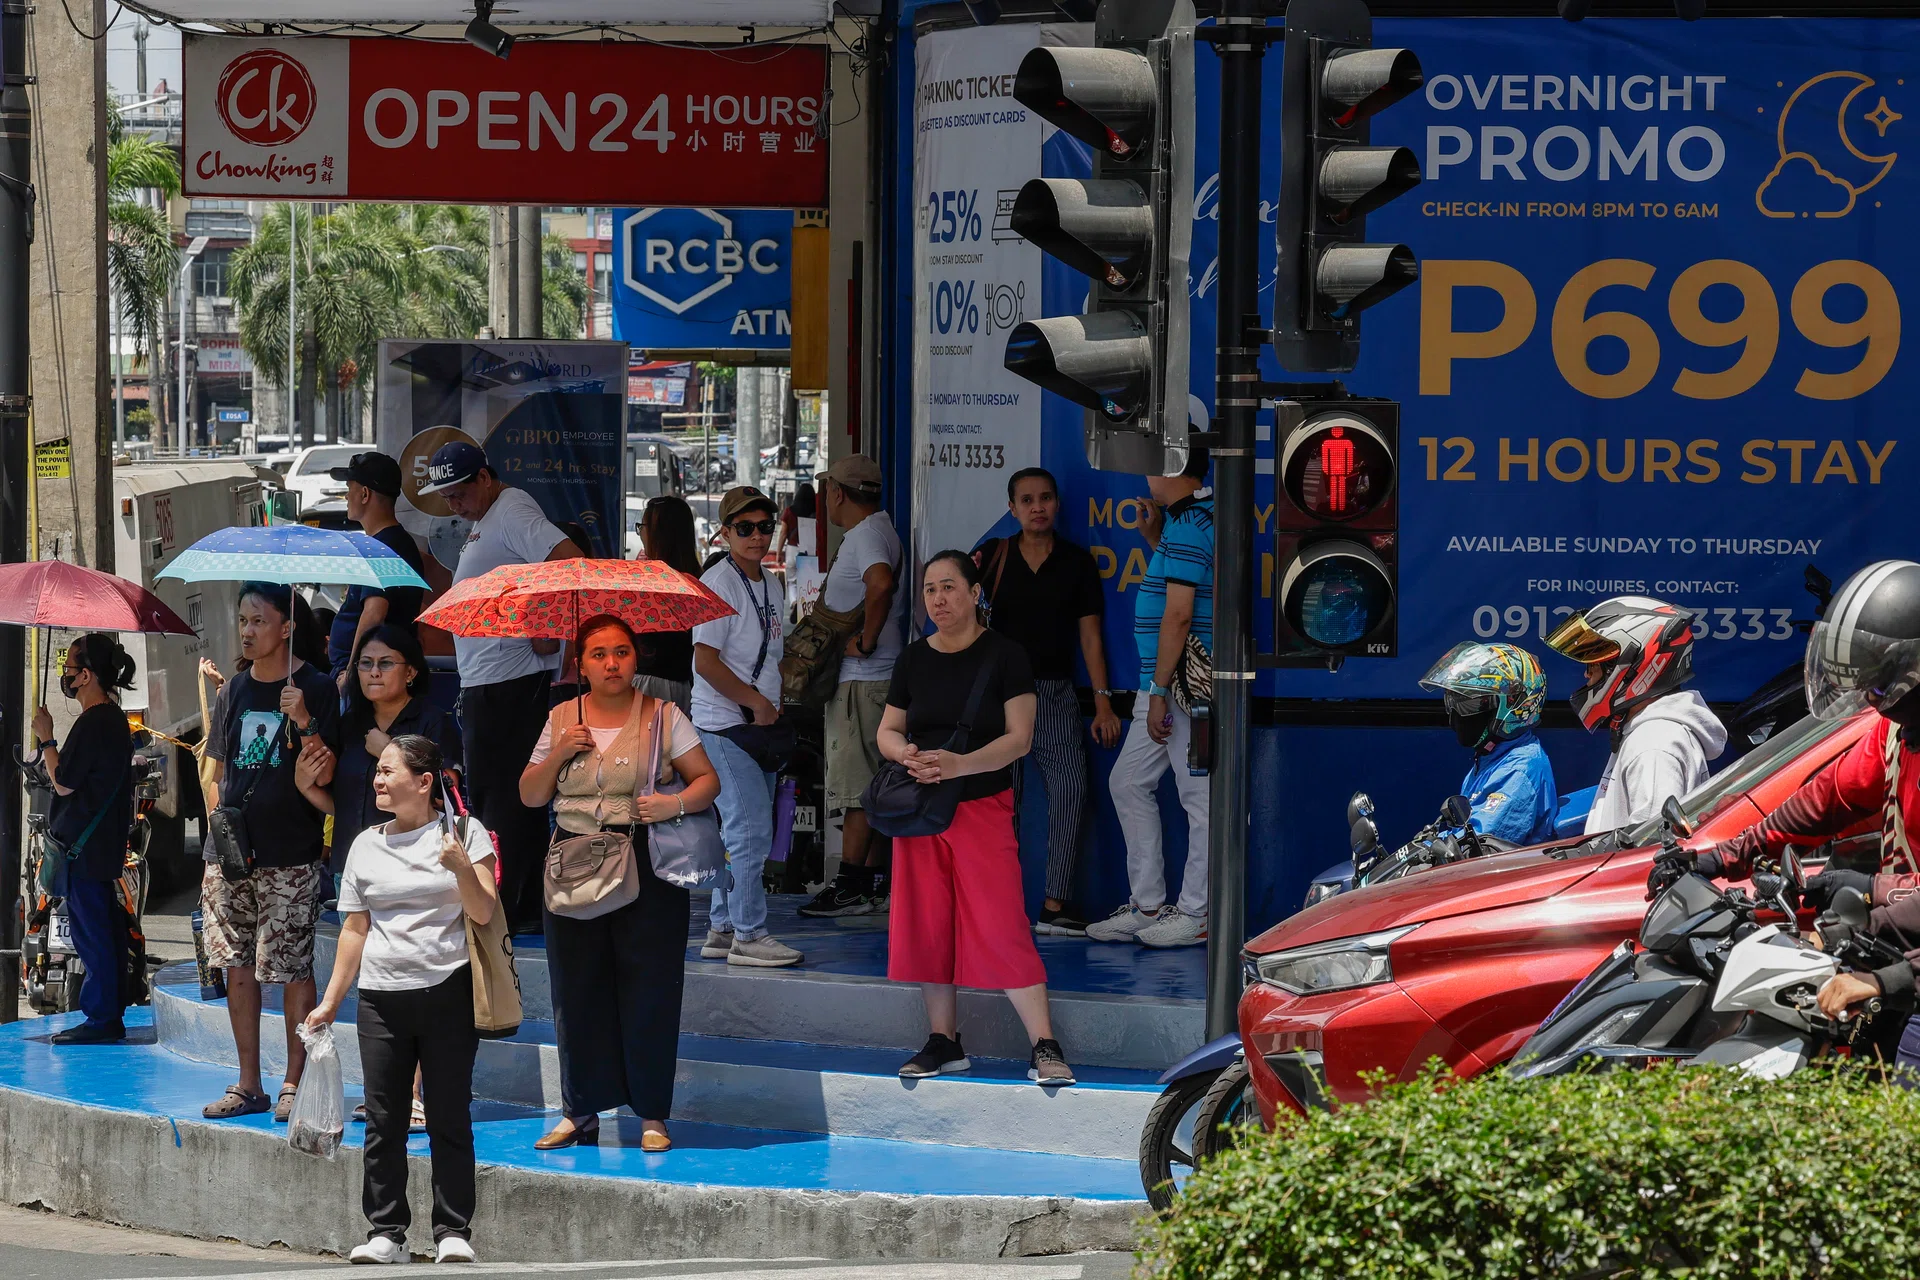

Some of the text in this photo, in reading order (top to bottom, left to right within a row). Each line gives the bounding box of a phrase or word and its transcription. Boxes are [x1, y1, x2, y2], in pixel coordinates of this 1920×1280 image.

[228, 63, 304, 132] Ck
[966, 74, 1017, 101] TICKE
[1426, 75, 1726, 111] OVERNIGHT
[363, 88, 676, 154] OPEN 24
[686, 94, 818, 126] HOURS
[944, 116, 953, 128] AS
[954, 112, 991, 128] DISCOUNT
[993, 110, 1026, 124] CARDS
[686, 130, 815, 153] 小时营业
[1427, 126, 1725, 182] PROMO
[196, 151, 317, 185] Chowking
[929, 189, 982, 243] 25%
[1422, 201, 1719, 218] CHECK-IN FROM 8PM TO 6AM
[645, 238, 780, 275] RCBC
[942, 254, 954, 265] STAY
[955, 254, 983, 265] DISCOUNT
[1419, 258, 1902, 400] P699
[930, 345, 973, 356] FOOD DISCOUNT
[934, 394, 961, 405] MONDAY
[962, 394, 972, 405] TO
[973, 394, 1019, 406] THURSDAY
[523, 429, 615, 445] BPO EMPLOYEE
[957, 425, 982, 434] CONTACT:
[504, 458, 616, 477] 12 and 24 hrs Stay
[939, 444, 960, 468] 413
[965, 444, 1004, 469] 3333
[1419, 437, 1897, 484] 12 HOURS STAY
[1447, 536, 1822, 555] AVAILABLE SUNDAY TO THURSDAY
[1527, 579, 1739, 598] FOR INQUIRES, CONTACT:
[1848, 667, 1860, 675] IT
